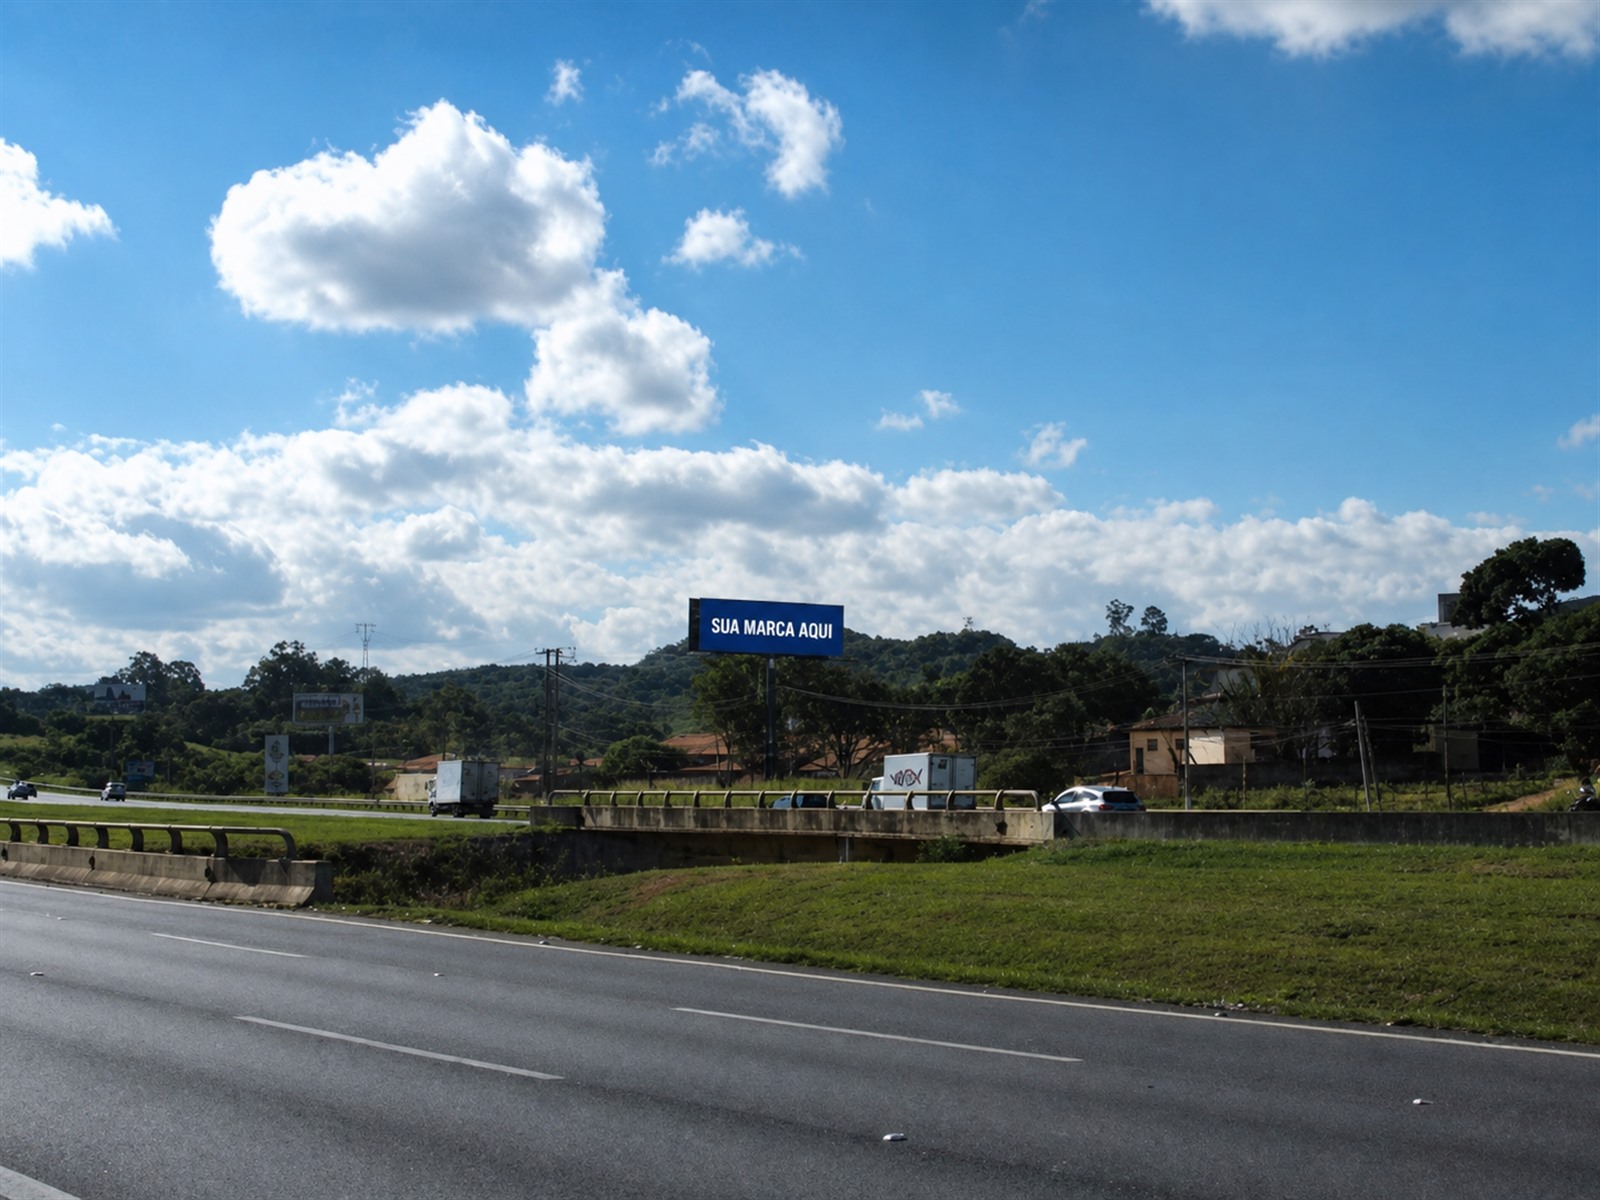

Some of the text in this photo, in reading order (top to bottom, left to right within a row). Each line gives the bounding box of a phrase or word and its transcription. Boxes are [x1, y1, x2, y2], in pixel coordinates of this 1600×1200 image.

[711, 617, 833, 640] SUA MARCA AQUI
